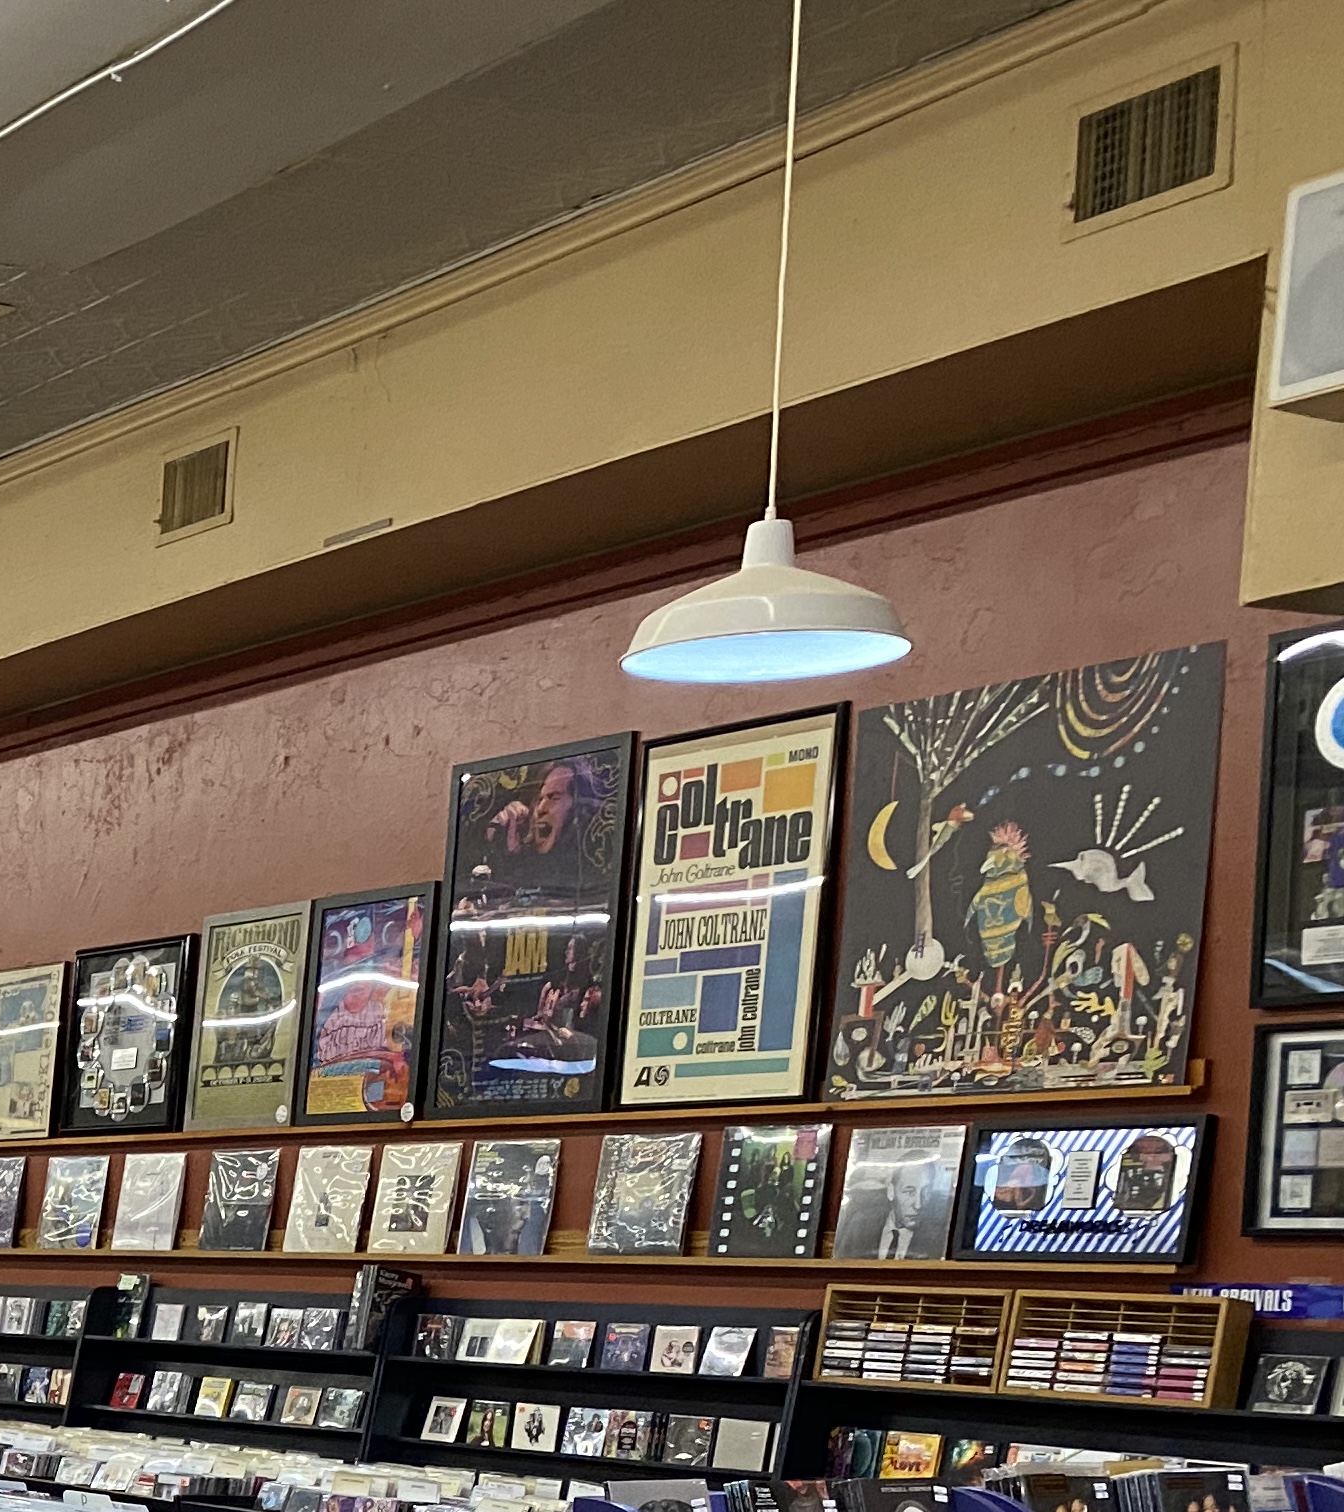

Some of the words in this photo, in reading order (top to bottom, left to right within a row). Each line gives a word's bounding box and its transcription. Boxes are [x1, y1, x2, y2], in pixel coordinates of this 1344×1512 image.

[788, 746, 819, 763] MONO
[651, 869, 683, 887] John
[686, 864, 736, 883] Coltrane
[659, 917, 695, 950] JOHN
[697, 908, 768, 947] COLTRANE
[213, 919, 301, 960] RICHMOND
[248, 945, 283, 957] FESTIVAL
[742, 968, 761, 1021] coltrane
[639, 1008, 697, 1026] COLTRANE
[695, 1040, 736, 1055] coltrane
